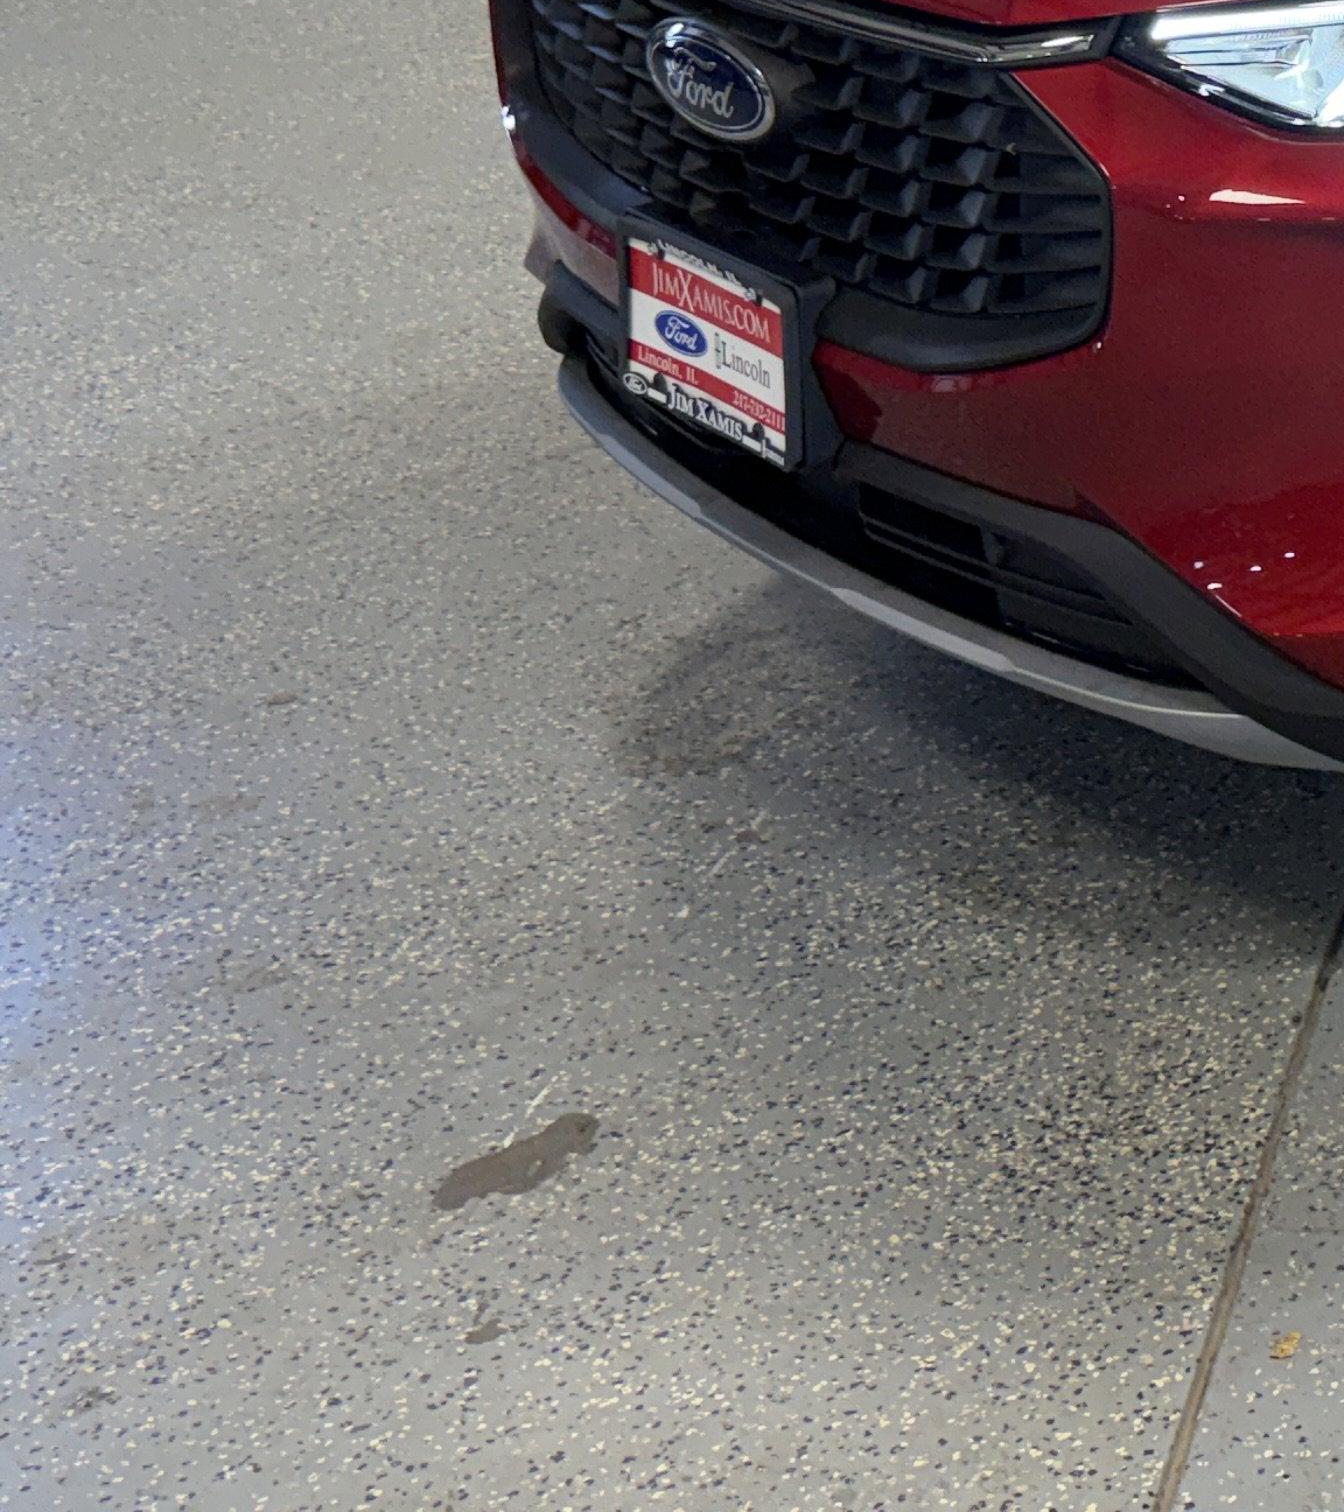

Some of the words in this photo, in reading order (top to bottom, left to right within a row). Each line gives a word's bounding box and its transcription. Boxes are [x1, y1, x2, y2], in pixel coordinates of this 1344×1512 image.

[666, 46, 735, 119] Ford
[652, 262, 771, 345] JIMXAMIS.COM
[664, 316, 698, 351] Ford
[721, 340, 771, 389] Lincoln
[667, 384, 695, 418] JIM
[694, 397, 743, 441] XAMIS
